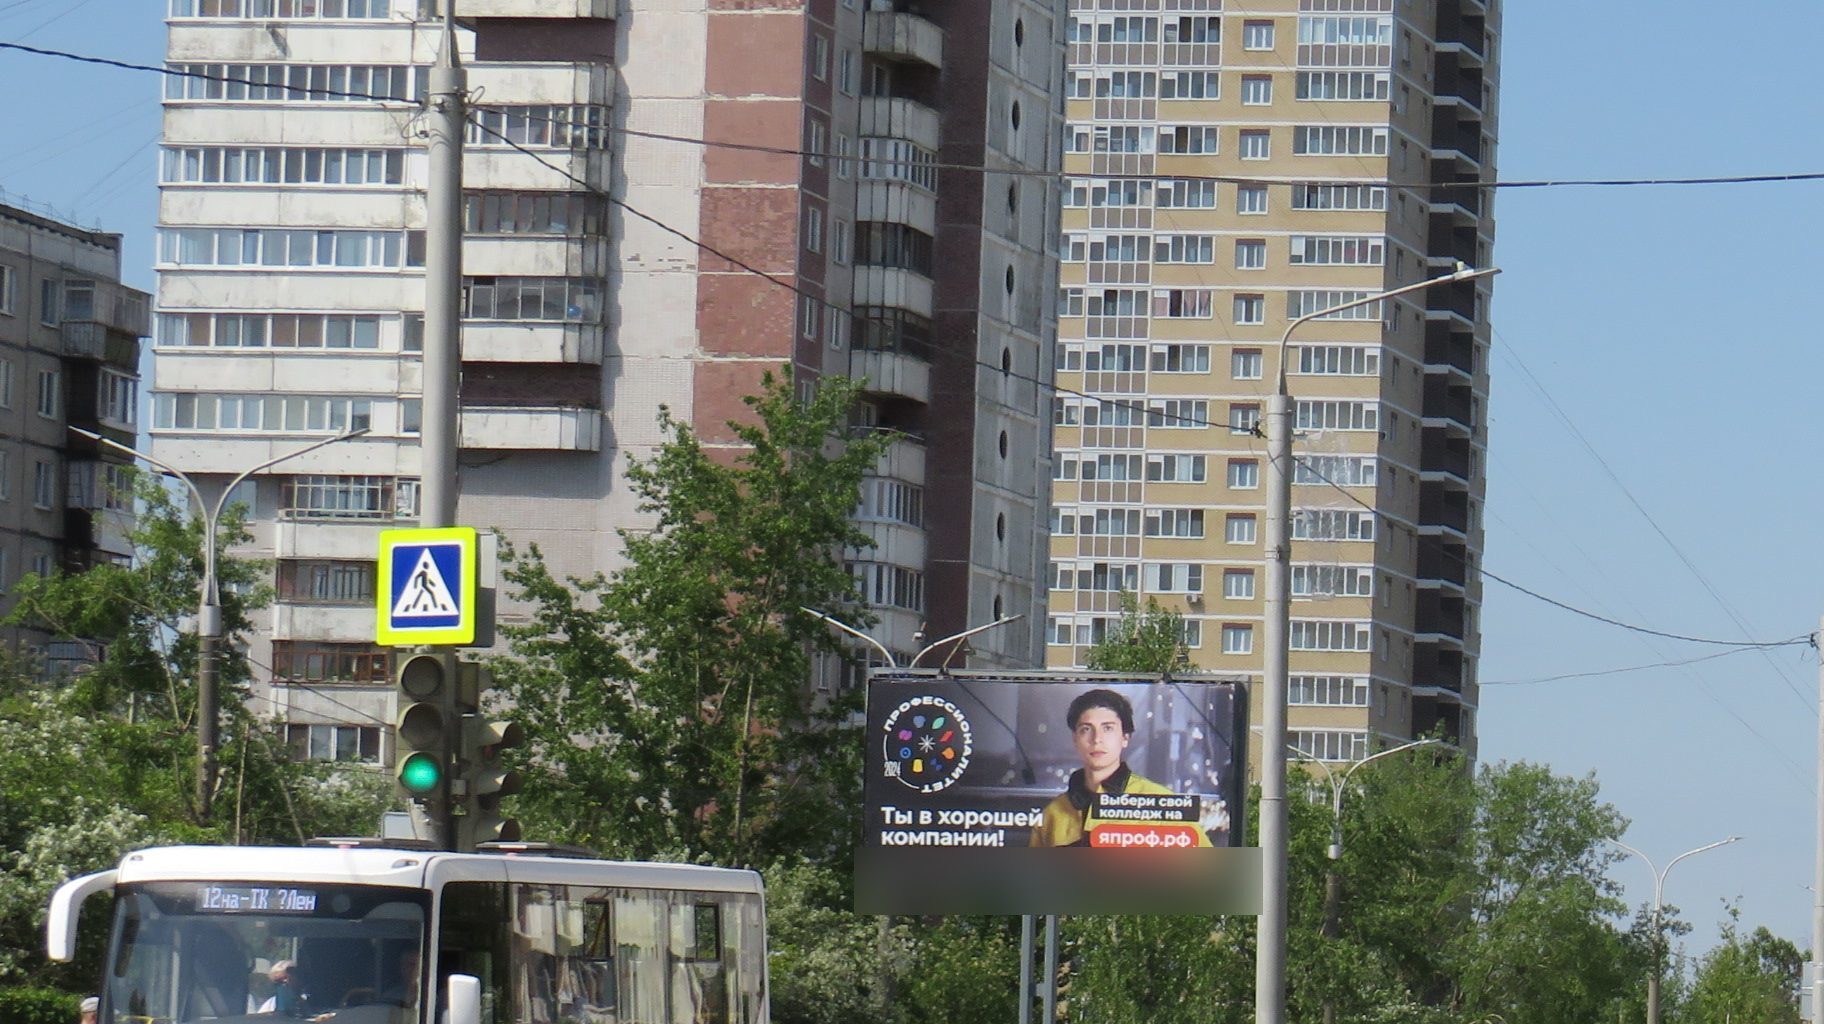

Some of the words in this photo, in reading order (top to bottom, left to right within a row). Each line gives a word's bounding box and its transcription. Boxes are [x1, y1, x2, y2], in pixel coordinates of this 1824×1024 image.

[883, 696, 973, 793] ПРОФЕССИОНАЛИТЕТ
[883, 761, 901, 777] 2024
[1100, 793, 1156, 809] Выбери
[1158, 794, 1193, 808] свой
[880, 806, 913, 825] Ты
[919, 810, 933, 825] в
[938, 808, 1044, 830] хорошей
[1099, 808, 1163, 820] колледж
[1164, 809, 1183, 820] на
[881, 829, 1005, 848] компании!
[1098, 829, 1191, 848] япроф.рф
